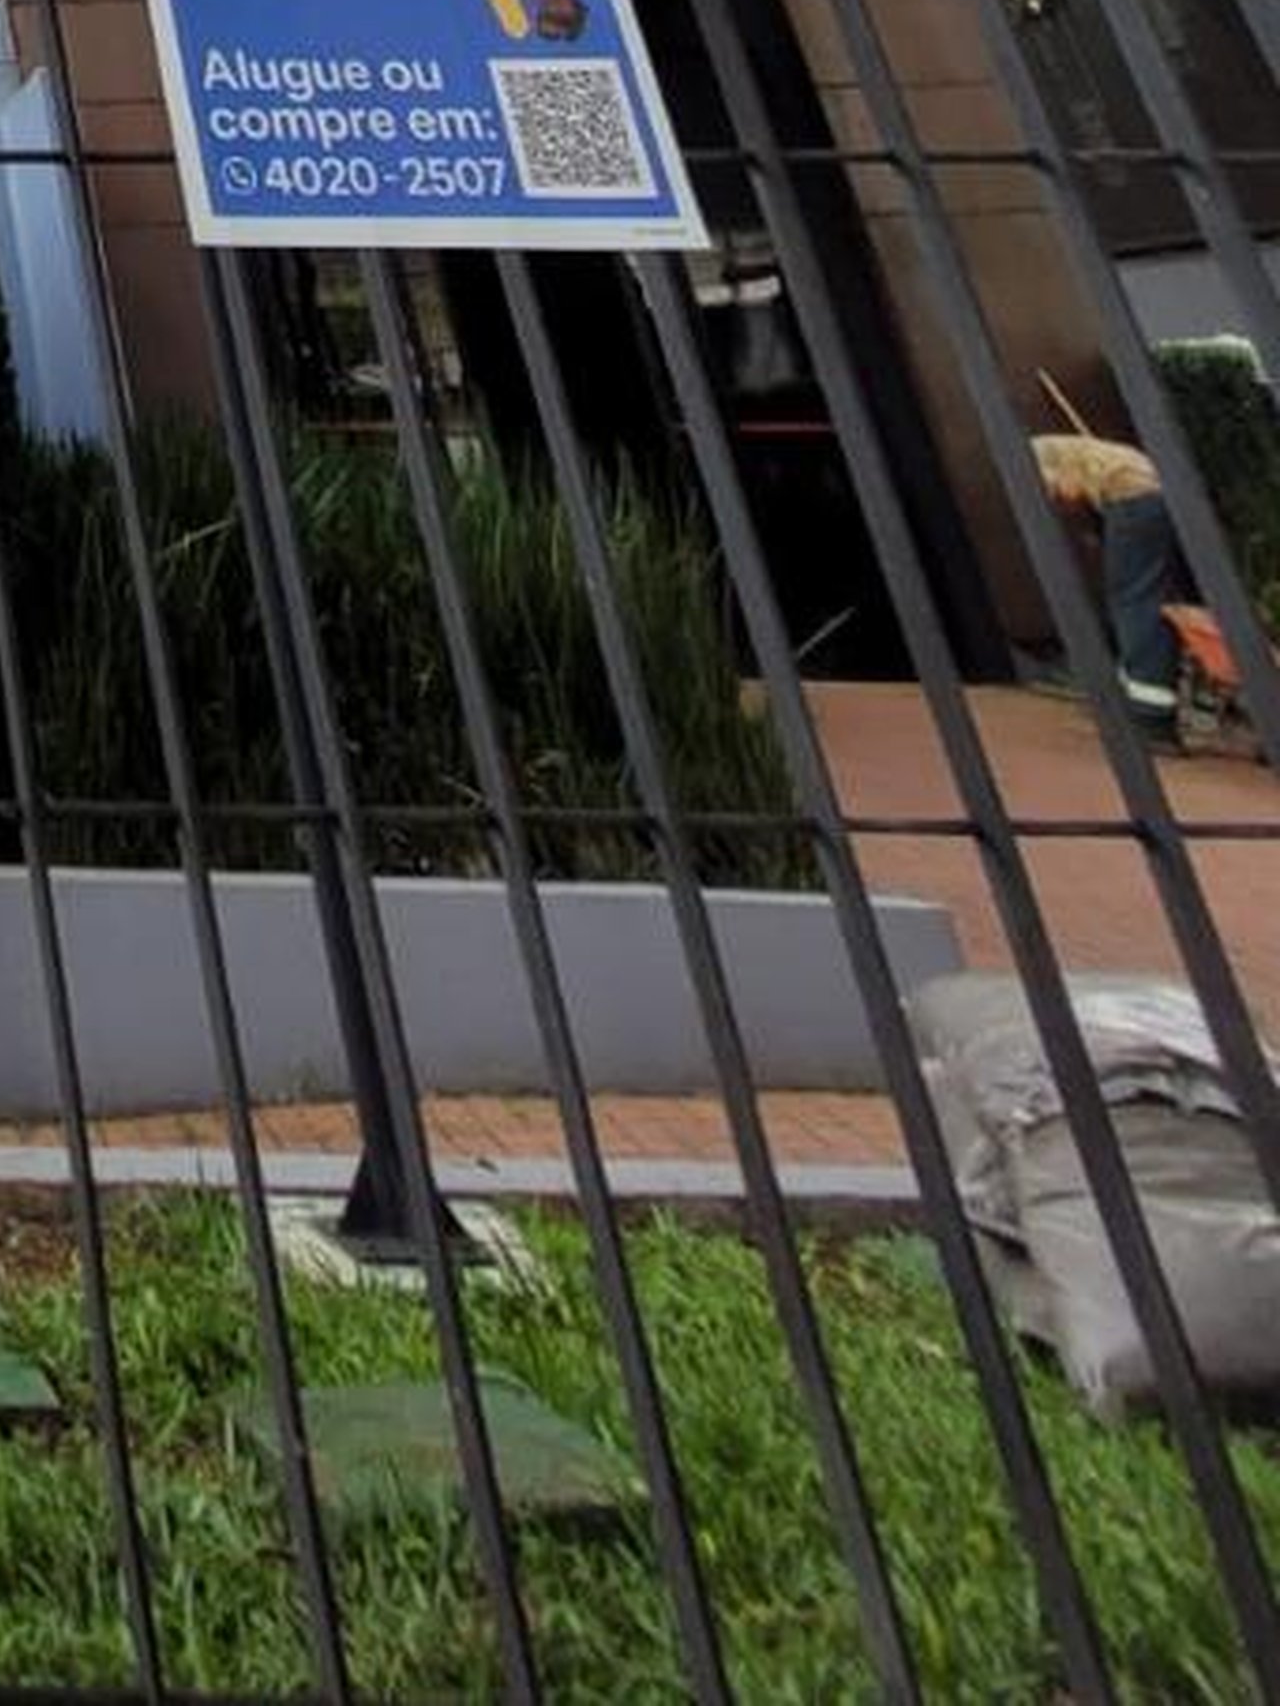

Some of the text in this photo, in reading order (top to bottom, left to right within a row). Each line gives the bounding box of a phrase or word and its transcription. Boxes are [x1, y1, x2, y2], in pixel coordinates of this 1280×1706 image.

[203, 48, 443, 102] Alugue ou
[209, 106, 499, 151] compre em:
[265, 155, 506, 196] 4020-2507
